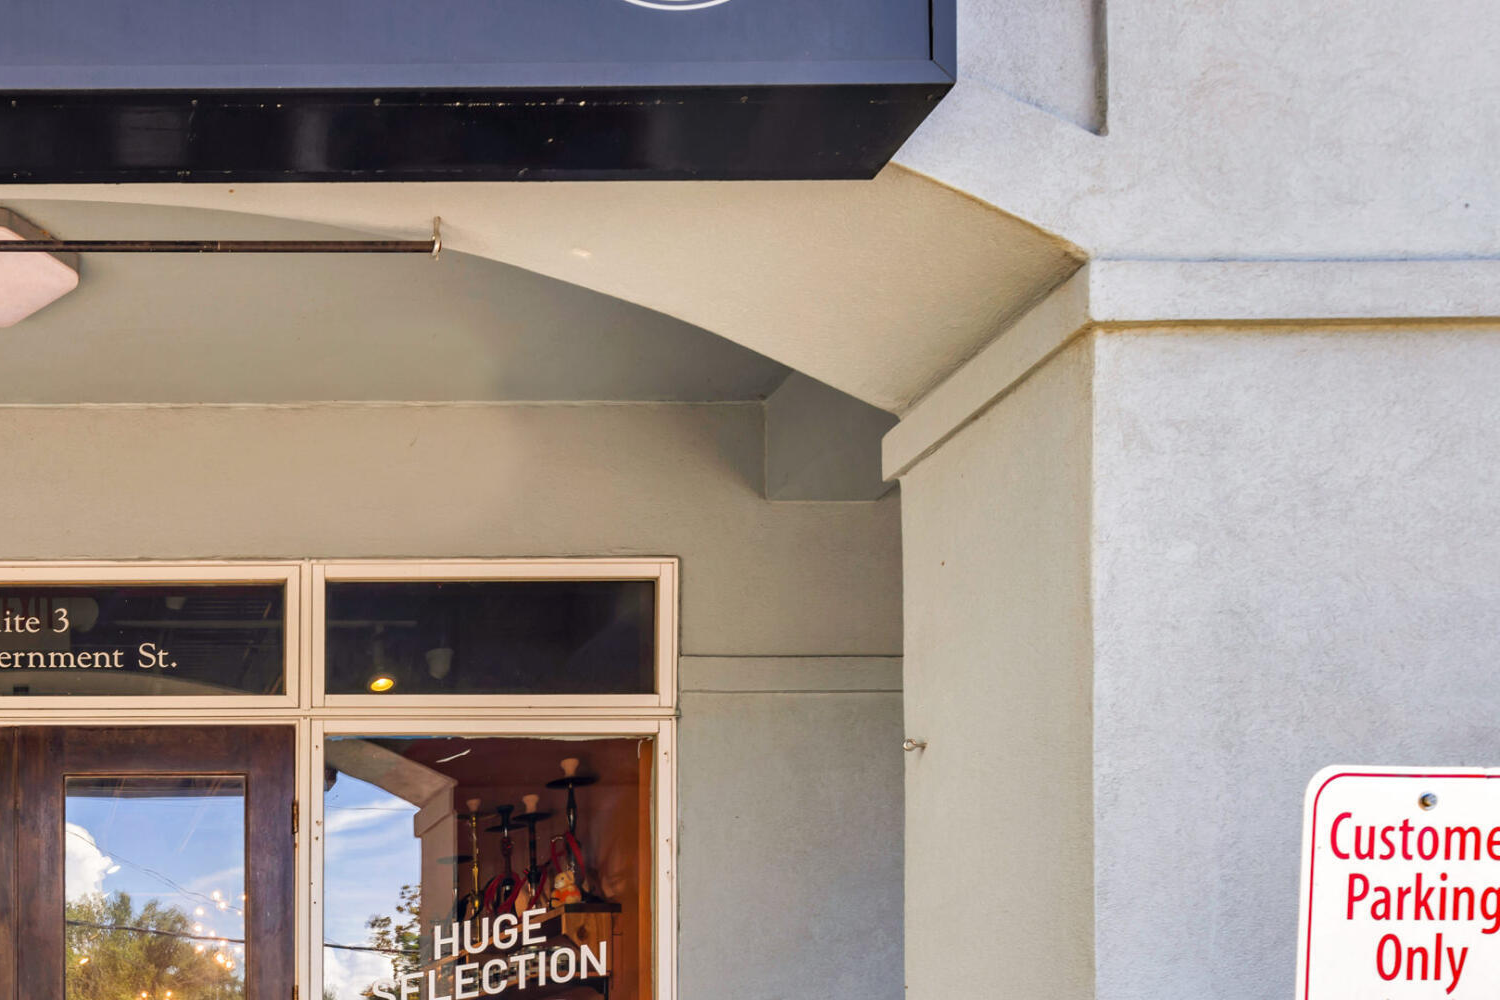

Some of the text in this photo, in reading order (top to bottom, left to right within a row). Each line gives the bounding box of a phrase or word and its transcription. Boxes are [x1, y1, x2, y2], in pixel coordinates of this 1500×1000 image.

[53, 607, 70, 633] 3
[138, 642, 178, 669] St.
[1329, 811, 1500, 861] Custome
[1345, 872, 1500, 935] Parking
[433, 907, 548, 960] HUGE
[1375, 932, 1469, 995] Only
